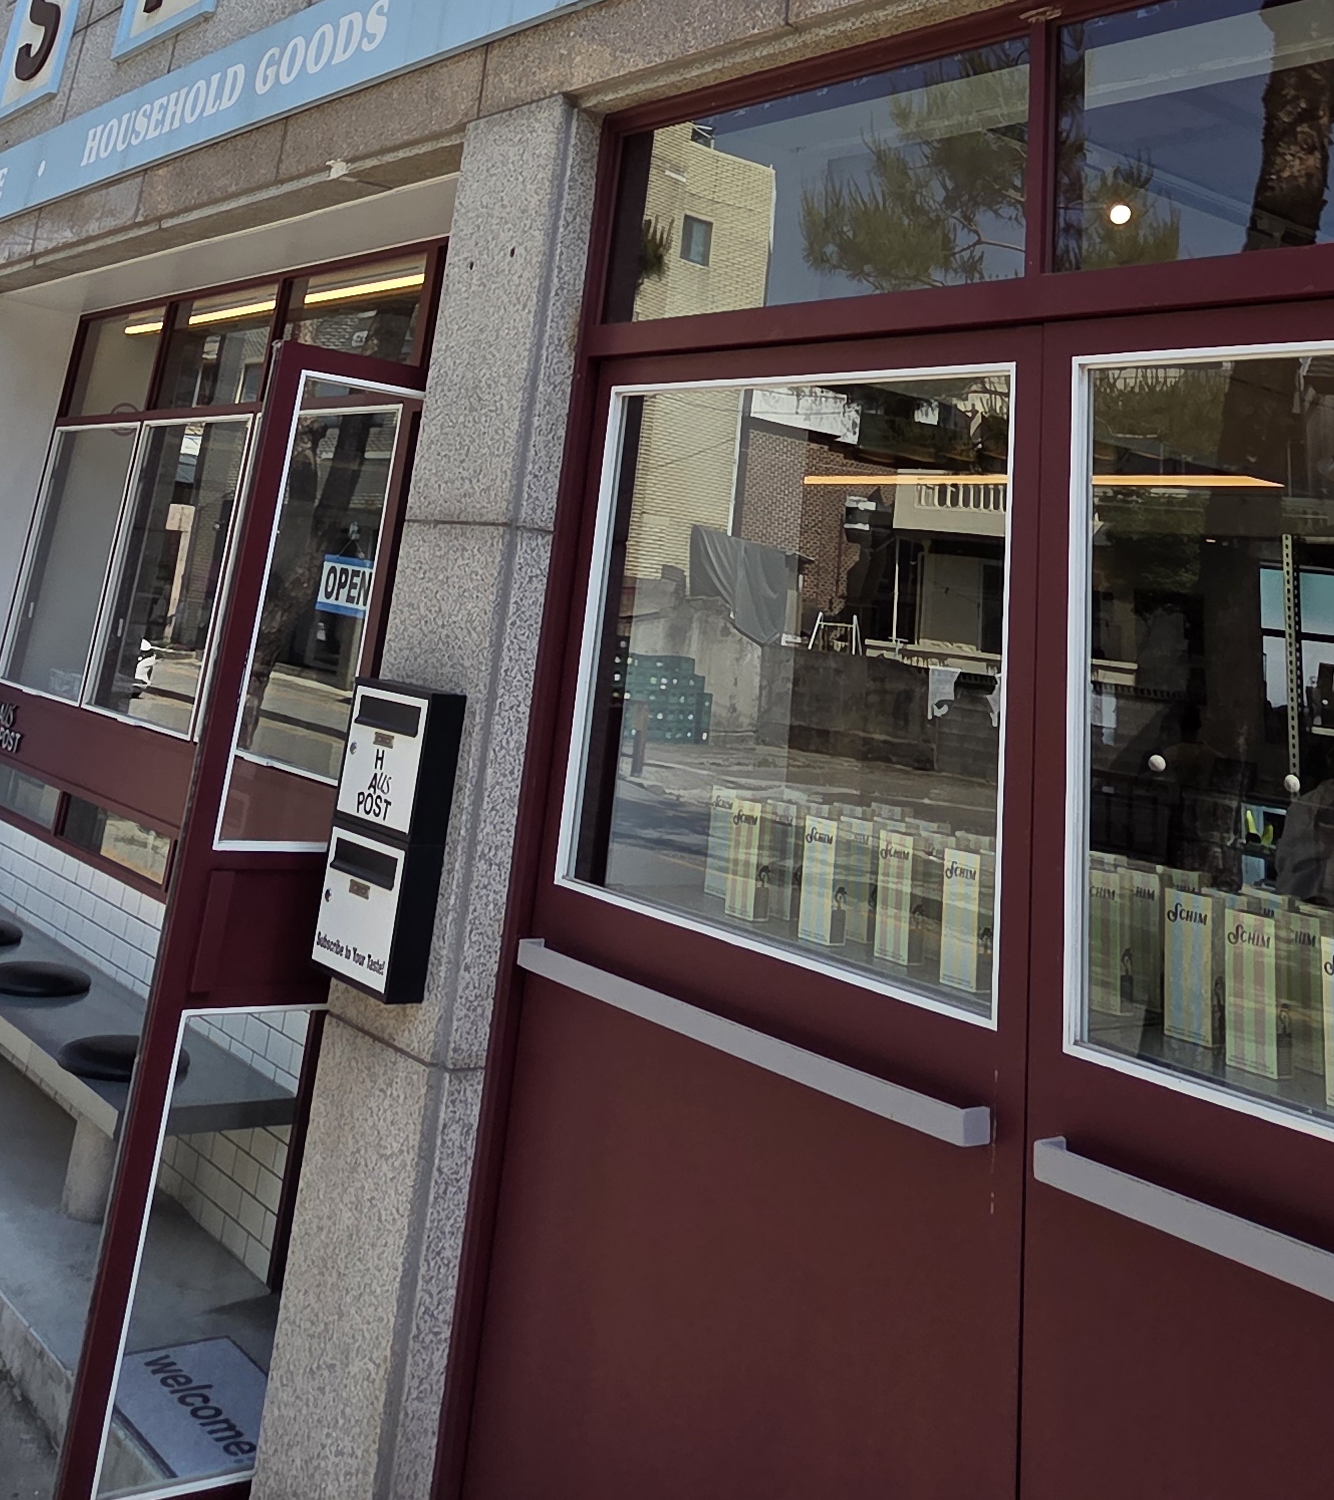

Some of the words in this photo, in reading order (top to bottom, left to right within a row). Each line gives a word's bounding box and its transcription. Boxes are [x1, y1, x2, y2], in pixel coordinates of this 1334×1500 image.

[80, 63, 245, 167] HOUSEHOLD
[254, 0, 390, 95] GOODS
[324, 565, 373, 607] OPEN
[374, 748, 385, 771] H
[356, 791, 392, 822] POST
[806, 826, 834, 845] SCHIM
[945, 860, 977, 881] SCHIM
[1089, 885, 1116, 901] CHIM
[1167, 902, 1208, 926] SCHIM
[1227, 924, 1272, 949] SCHIM
[143, 1354, 258, 1457] welcome
